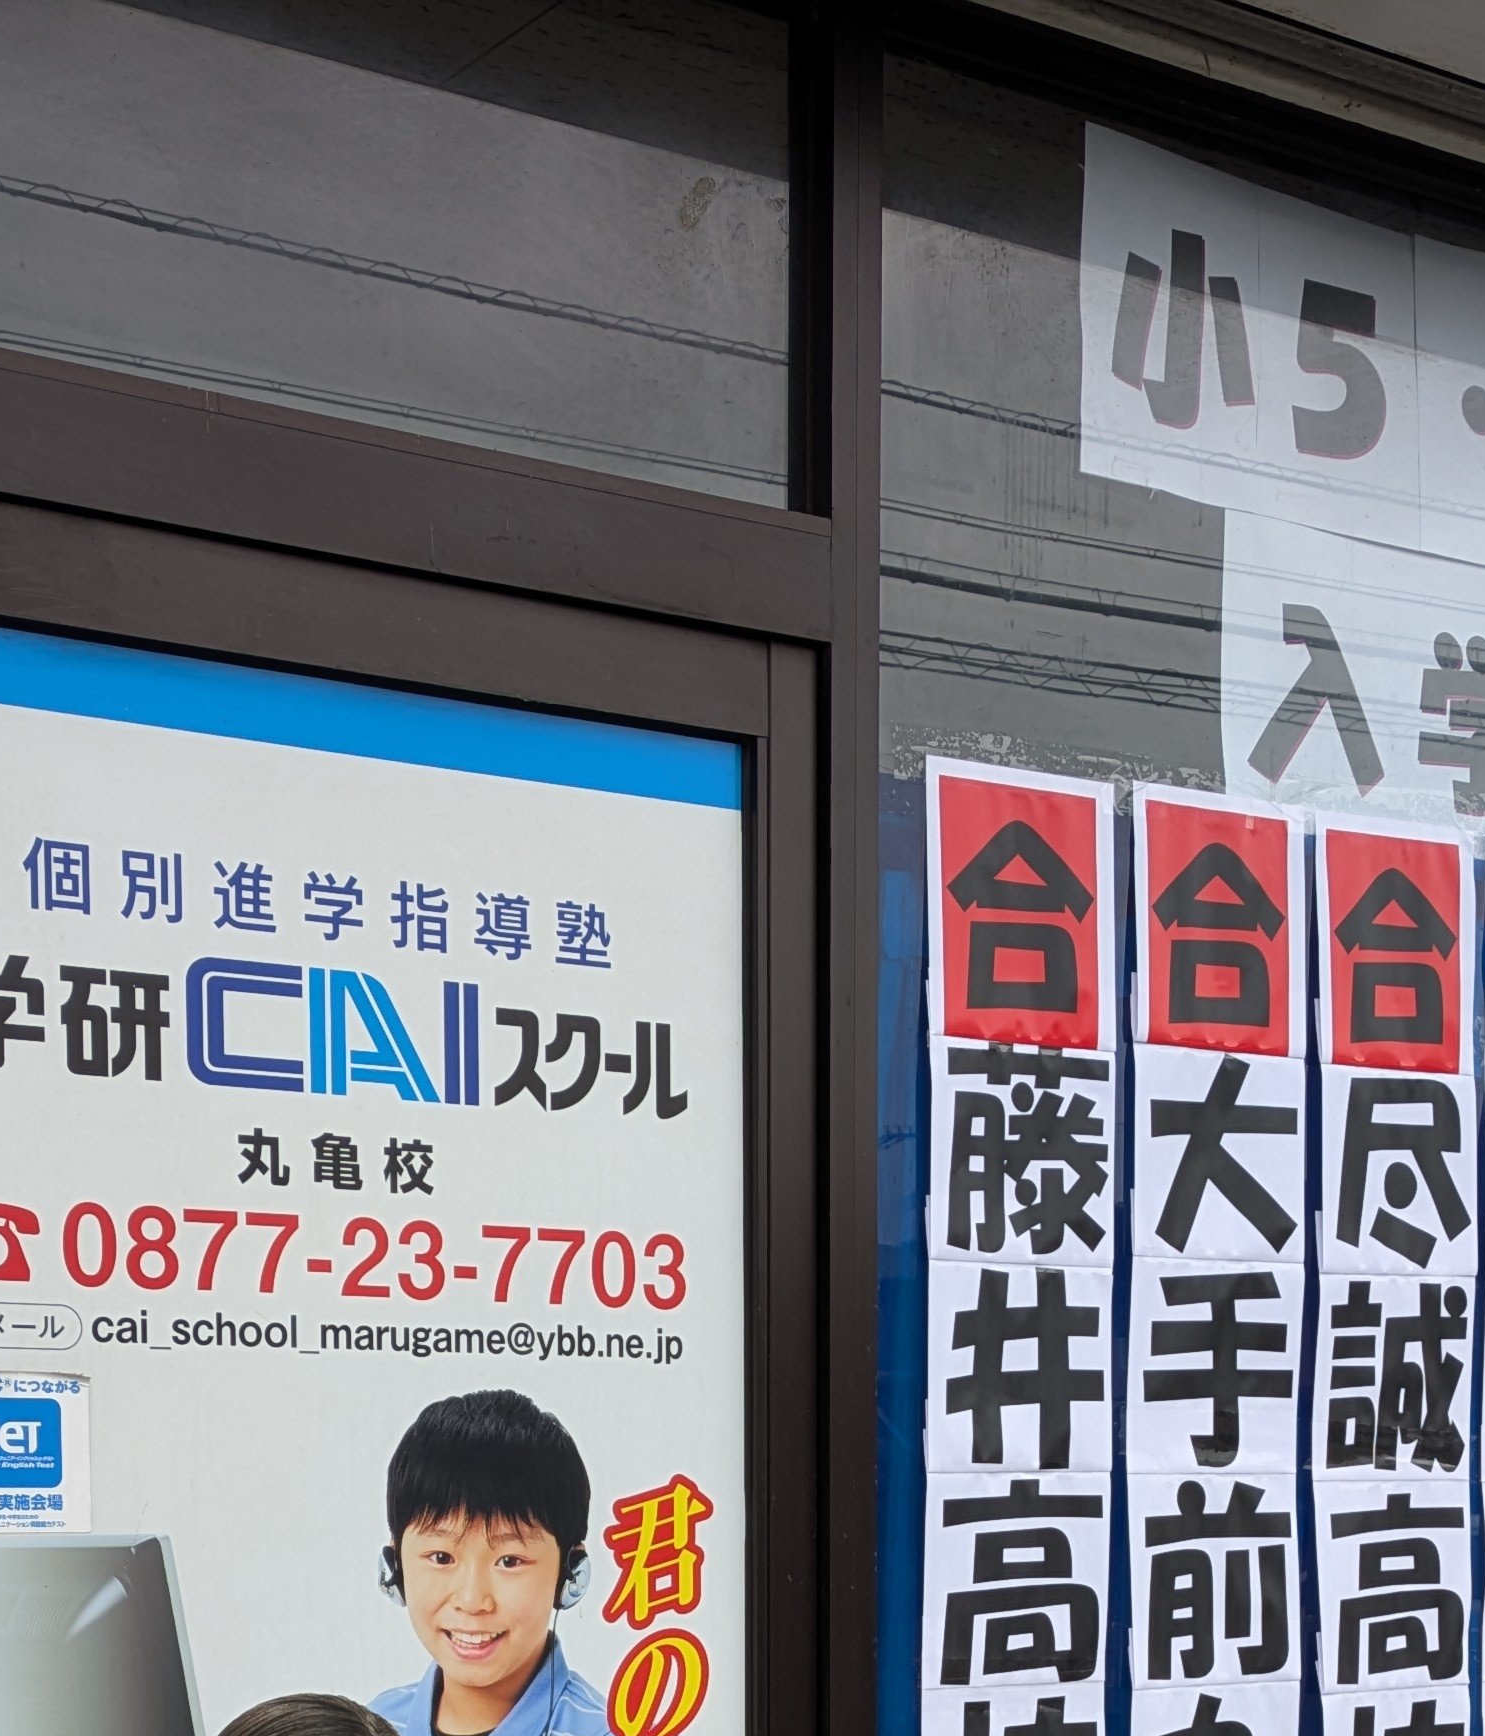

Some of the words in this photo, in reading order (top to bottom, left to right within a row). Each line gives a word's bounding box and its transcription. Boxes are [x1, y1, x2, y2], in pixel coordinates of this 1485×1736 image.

[22, 836, 612, 969] 個別進学指導塾
[237, 1127, 436, 1196] 丸亀校
[62, 1200, 688, 1310] 0877-23-7703
[90, 1309, 685, 1364] cai_school_marugame@ybb.ne.jp
